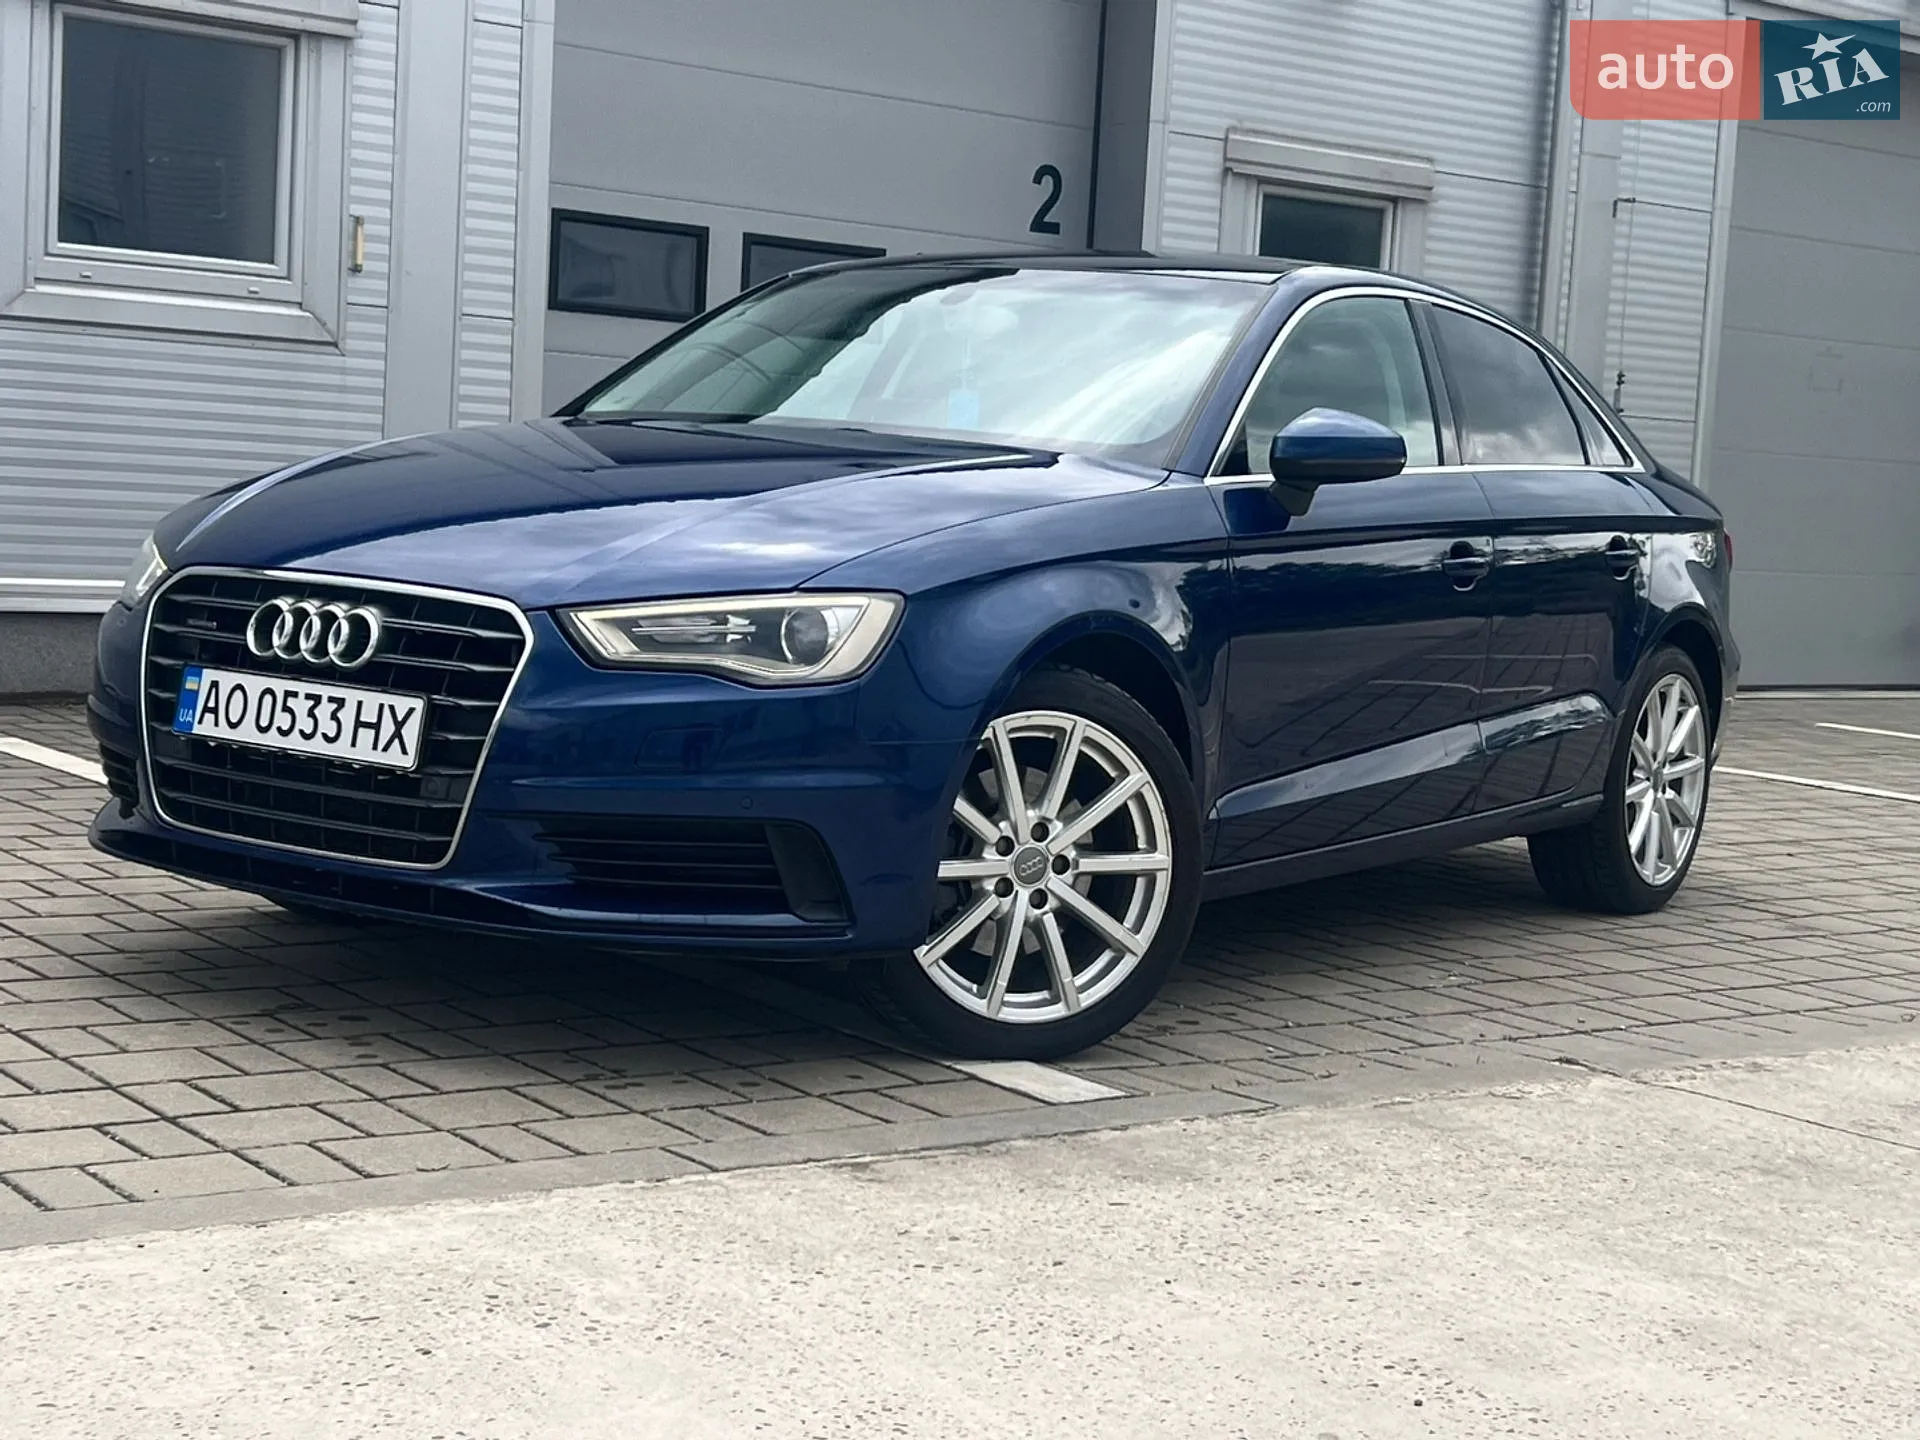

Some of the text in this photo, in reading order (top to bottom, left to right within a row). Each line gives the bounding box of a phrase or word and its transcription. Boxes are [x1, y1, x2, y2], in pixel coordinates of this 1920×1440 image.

[1029, 164, 1063, 236] 2
[178, 708, 194, 723] UA
[197, 680, 416, 756] AO 0533 HX
